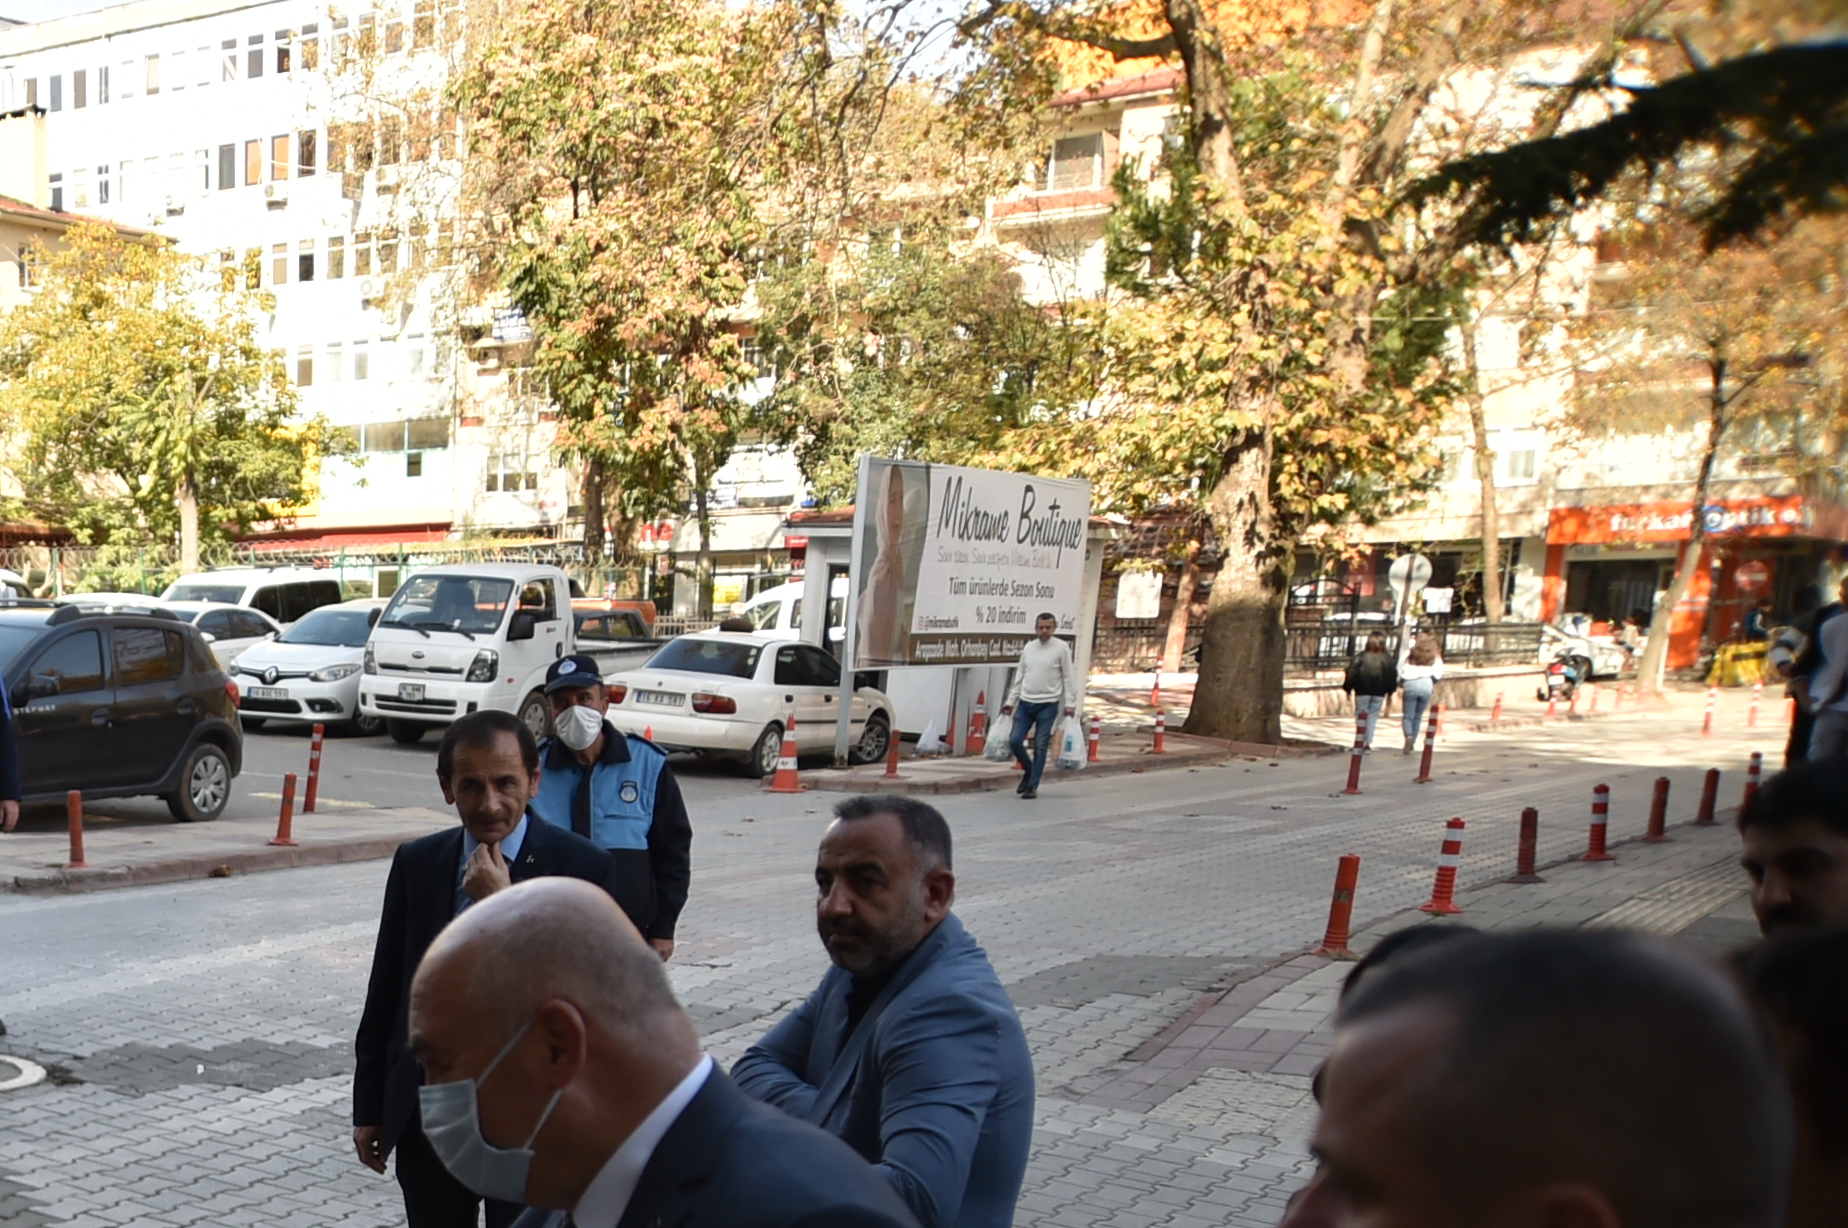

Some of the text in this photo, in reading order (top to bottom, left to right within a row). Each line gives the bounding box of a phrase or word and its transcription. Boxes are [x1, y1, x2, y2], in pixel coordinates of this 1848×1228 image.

[1017, 484, 1083, 569] Boutique
[949, 576, 1055, 599] Tüm ürünlerde Sezon Sonu
[976, 606, 1027, 624] % 20 indirim
[13, 704, 56, 716] STEPWAY
